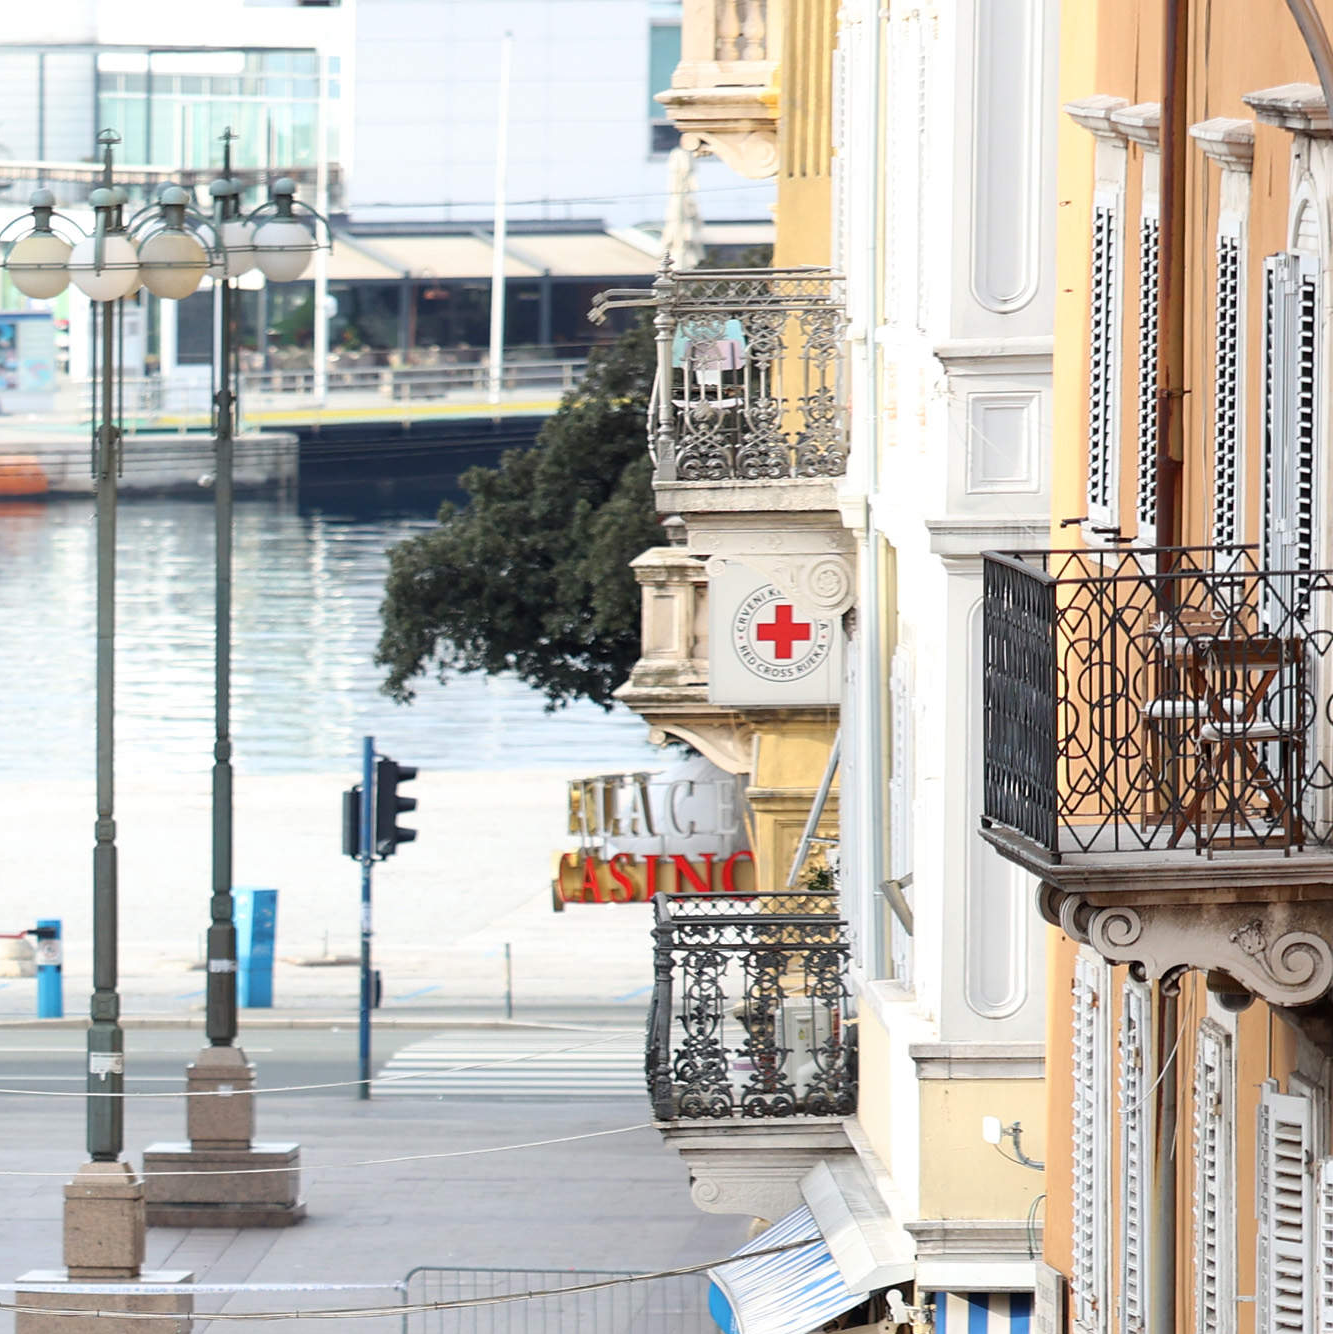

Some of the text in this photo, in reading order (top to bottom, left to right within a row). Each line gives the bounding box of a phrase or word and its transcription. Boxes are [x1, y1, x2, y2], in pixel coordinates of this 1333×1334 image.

[737, 591, 767, 633] CRVENI
[739, 643, 827, 678] RED CROSS RIJEKA
